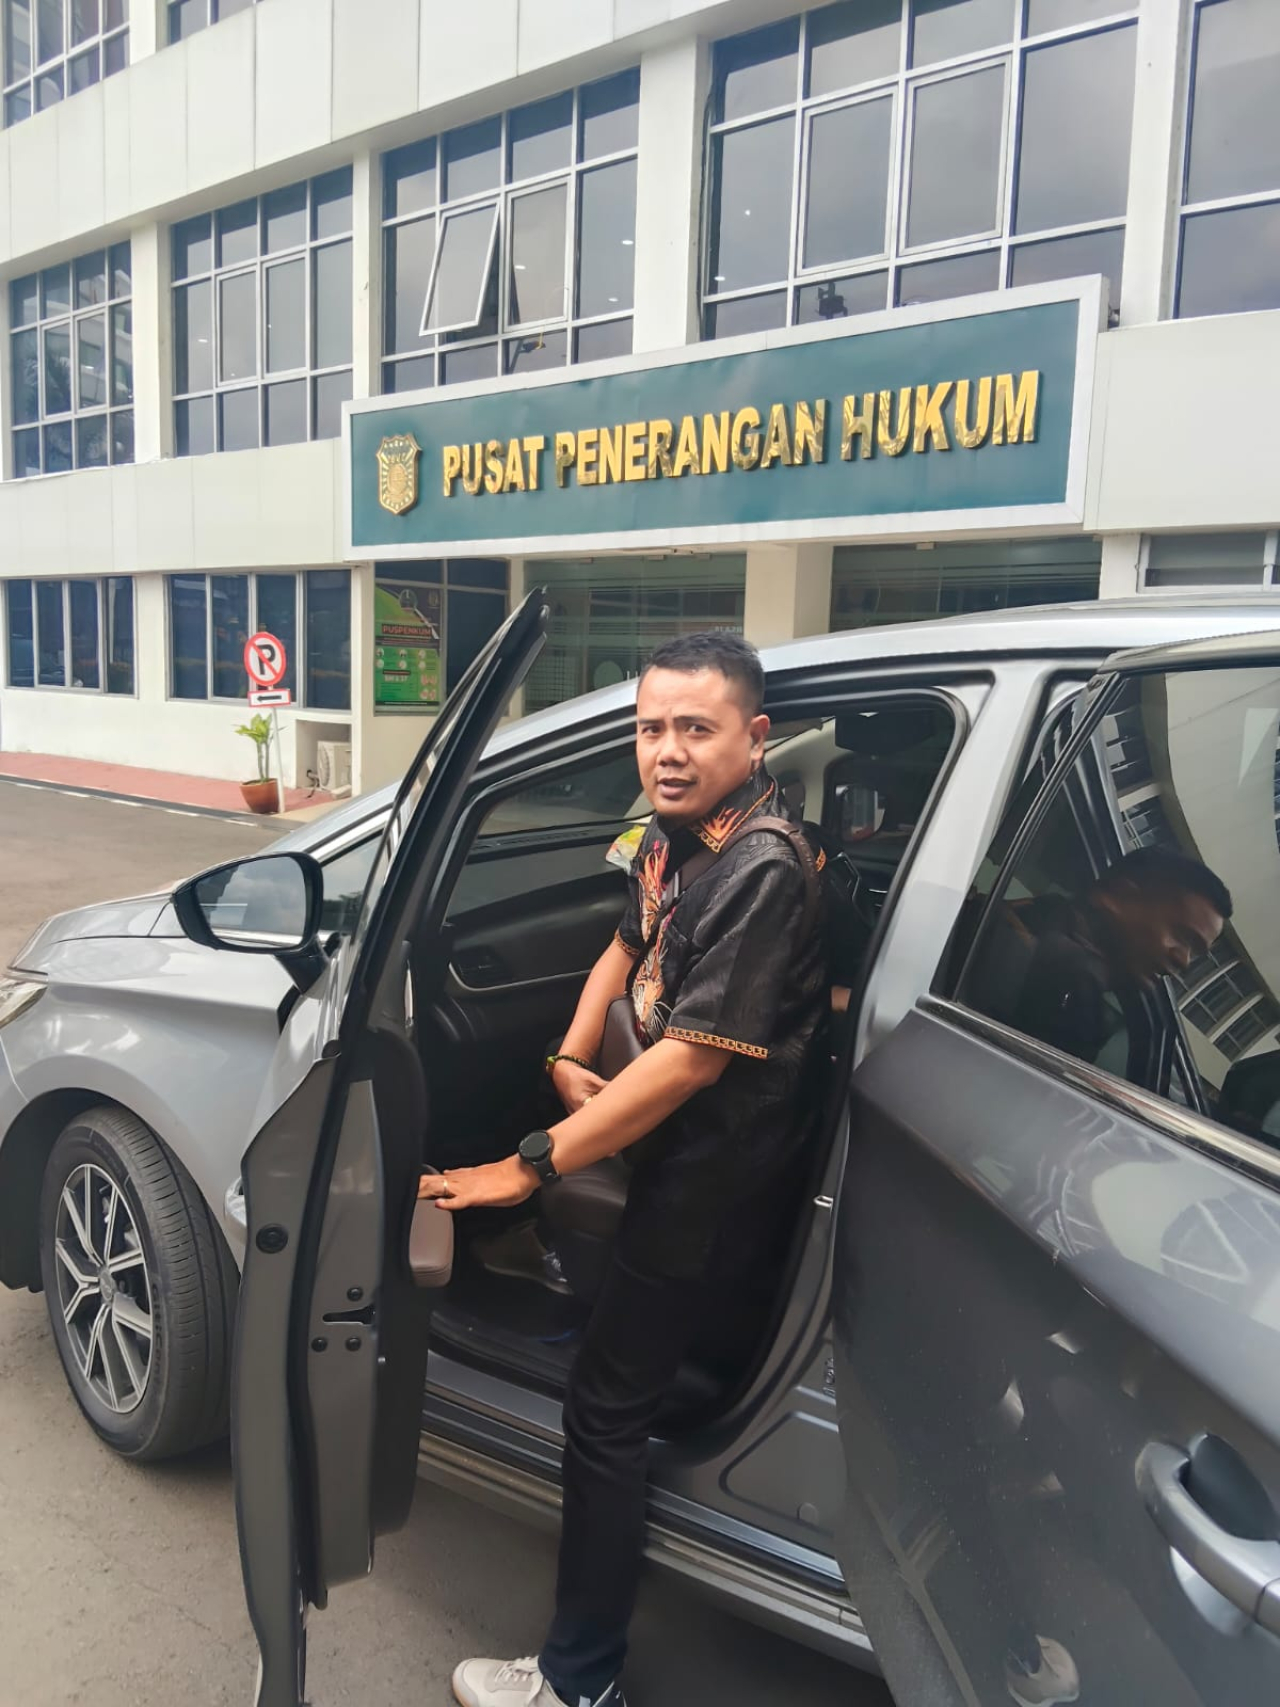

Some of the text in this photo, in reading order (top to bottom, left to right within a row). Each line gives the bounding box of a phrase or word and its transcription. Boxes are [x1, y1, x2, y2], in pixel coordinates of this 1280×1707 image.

[443, 370, 1039, 497] PUSAT PENERANGAN HUKUM
[382, 625, 431, 635] PUSPENKUM
[257, 644, 276, 675] P
